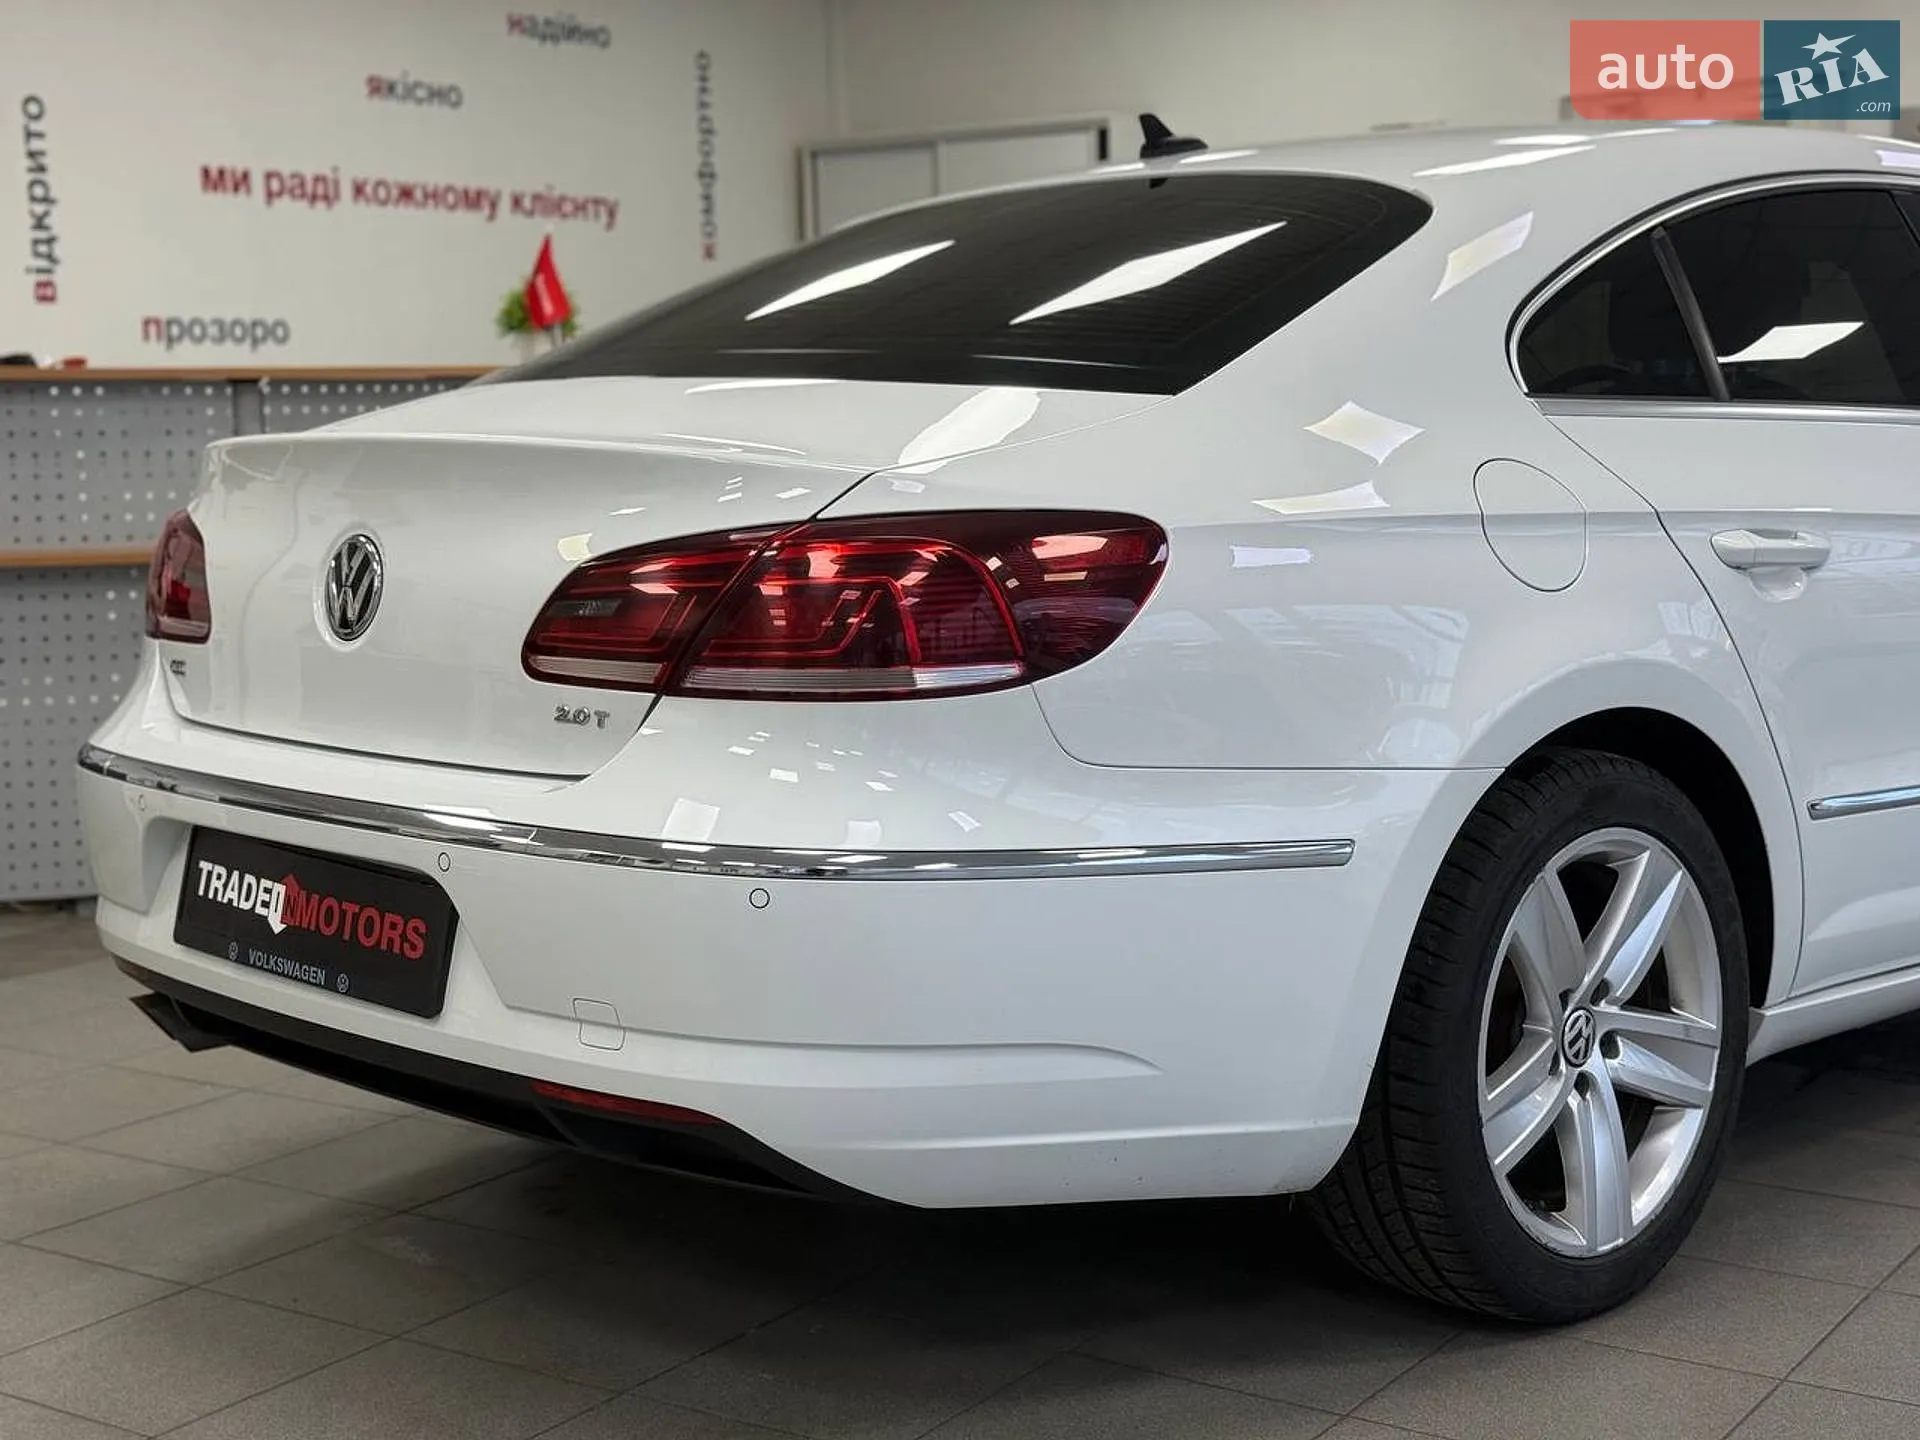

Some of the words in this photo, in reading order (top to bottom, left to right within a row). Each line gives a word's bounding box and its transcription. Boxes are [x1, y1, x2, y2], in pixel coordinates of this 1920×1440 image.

[507, 12, 611, 49] надійно
[366, 70, 463, 110] якісно
[22, 95, 60, 304] відкрито
[264, 166, 341, 208] раді
[351, 175, 501, 221] кожному
[510, 184, 619, 229] клієнту
[141, 315, 291, 353] прозоро
[198, 860, 272, 917] TRADE
[298, 889, 427, 960] MOTORS
[248, 948, 325, 985] VOLKSWAGEN
